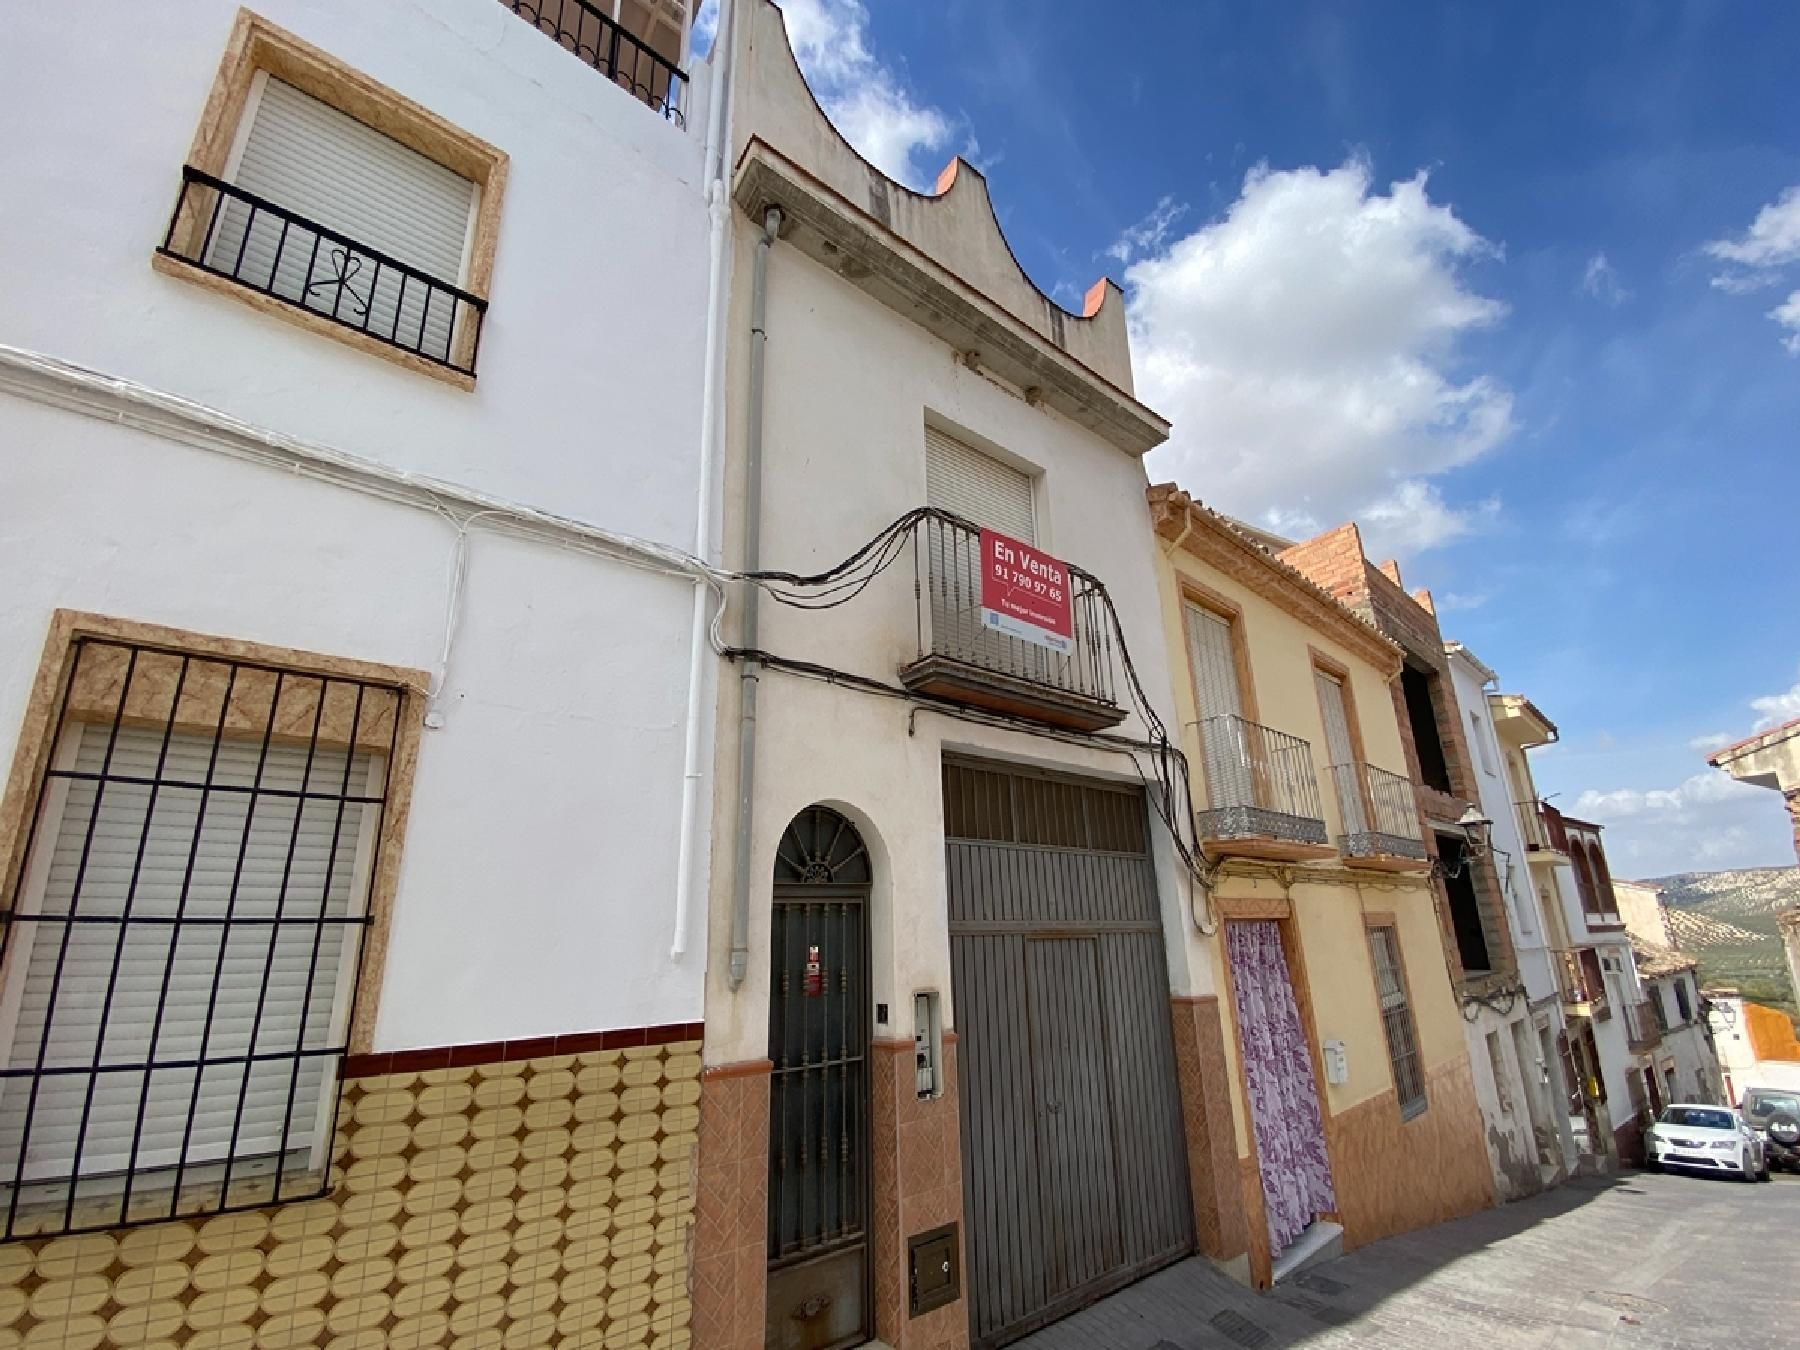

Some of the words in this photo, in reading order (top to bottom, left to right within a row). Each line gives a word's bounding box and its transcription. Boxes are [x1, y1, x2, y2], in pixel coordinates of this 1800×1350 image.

[994, 541, 1014, 564] En
[1019, 551, 1062, 585] Venta
[994, 565, 1008, 580] 91
[1012, 571, 1032, 589] 790
[1034, 581, 1047, 595] 97
[1049, 587, 1062, 602] 65
